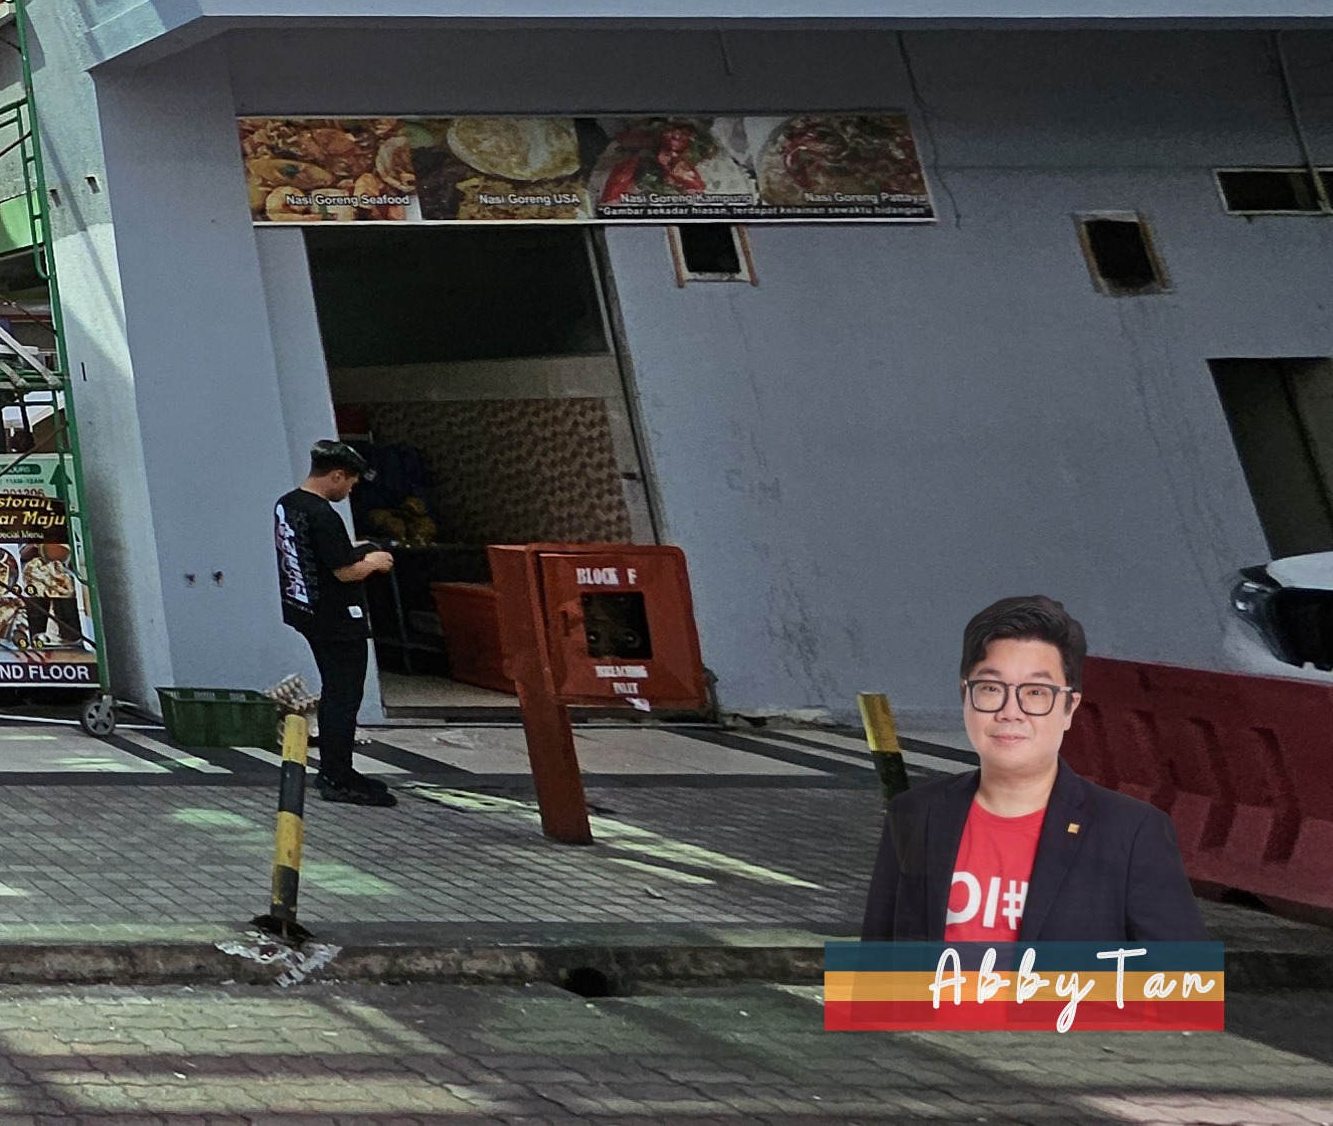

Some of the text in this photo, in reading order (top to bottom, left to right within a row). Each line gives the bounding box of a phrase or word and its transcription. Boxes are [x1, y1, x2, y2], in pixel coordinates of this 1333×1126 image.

[286, 194, 411, 208] Nasi Goreng Seafood
[479, 193, 581, 206] Nasi Goreng USA
[619, 193, 753, 205] Nasi Goreng Kampung
[804, 192, 928, 205] Nasi Goreng Pattaya
[646, 207, 689, 216] sekadar
[22, 511, 66, 529] Maju
[21, 529, 44, 539] Menu
[576, 567, 638, 585] BLOCK F
[28, 664, 90, 680] FLOOR
